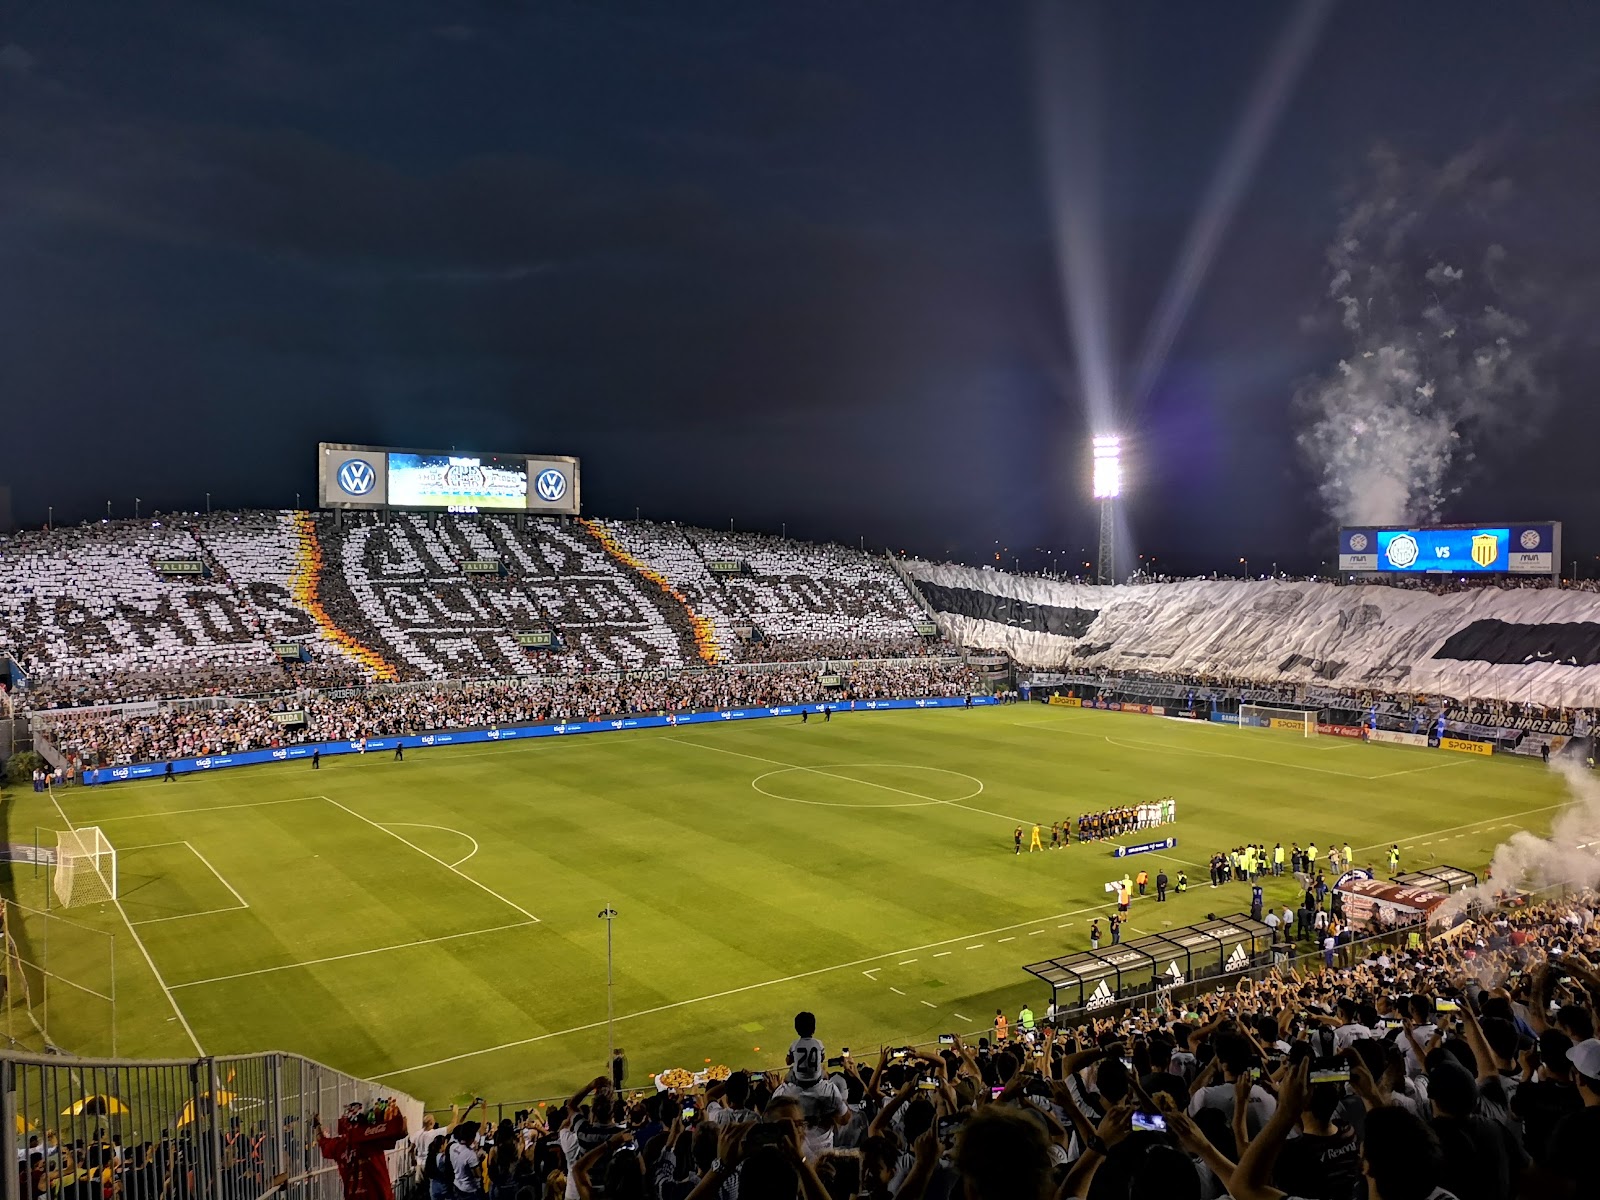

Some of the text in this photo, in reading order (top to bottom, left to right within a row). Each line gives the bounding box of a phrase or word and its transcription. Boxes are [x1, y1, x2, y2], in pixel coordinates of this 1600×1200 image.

[1435, 546, 1450, 558] VS
[160, 563, 198, 571] ALIDA
[518, 635, 549, 643] ALIDA
[467, 678, 519, 692] ESTADIO
[1054, 697, 1076, 705] SPORTS
[1447, 709, 1514, 728] NOSOTROS
[1514, 717, 1574, 735] HACEMOS
[1448, 740, 1484, 752] SPORTS
[1225, 956, 1250, 972] adidas
[1086, 994, 1115, 1011] adidas
[797, 1046, 818, 1073] 24
